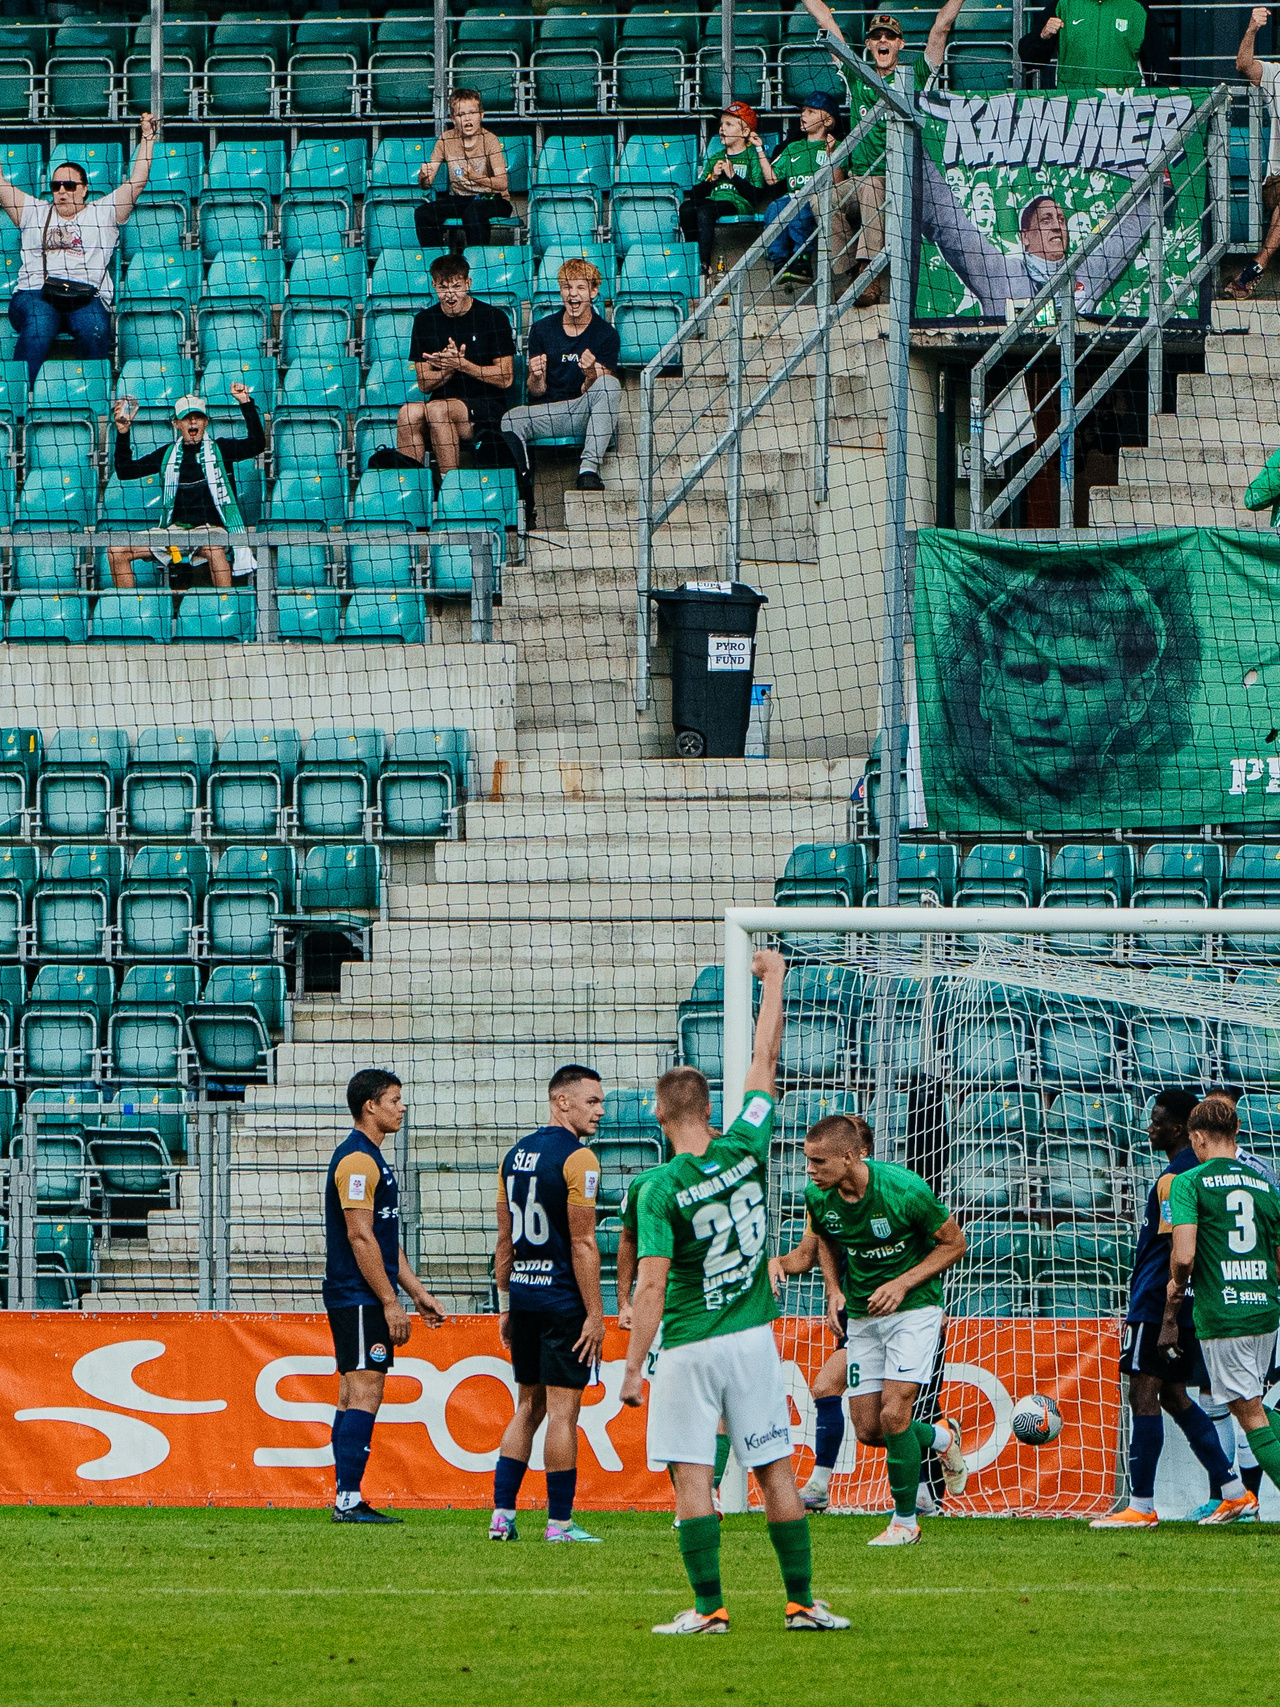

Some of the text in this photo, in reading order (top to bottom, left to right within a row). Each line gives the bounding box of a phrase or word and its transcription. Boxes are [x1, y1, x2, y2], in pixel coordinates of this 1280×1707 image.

[716, 643, 745, 652] PYRO
[716, 656, 745, 665] FUND
[1202, 1176, 1215, 1188] FC
[1214, 1173, 1242, 1188] FLORA
[676, 1189, 693, 1208] FC
[1226, 1189, 1257, 1254] 3
[692, 1181, 766, 1278] 26
[513, 1260, 553, 1272] ama
[1220, 1260, 1268, 1281] VAHER
[530, 1274, 553, 1286] LINN
[1239, 1291, 1268, 1302] SELVER
